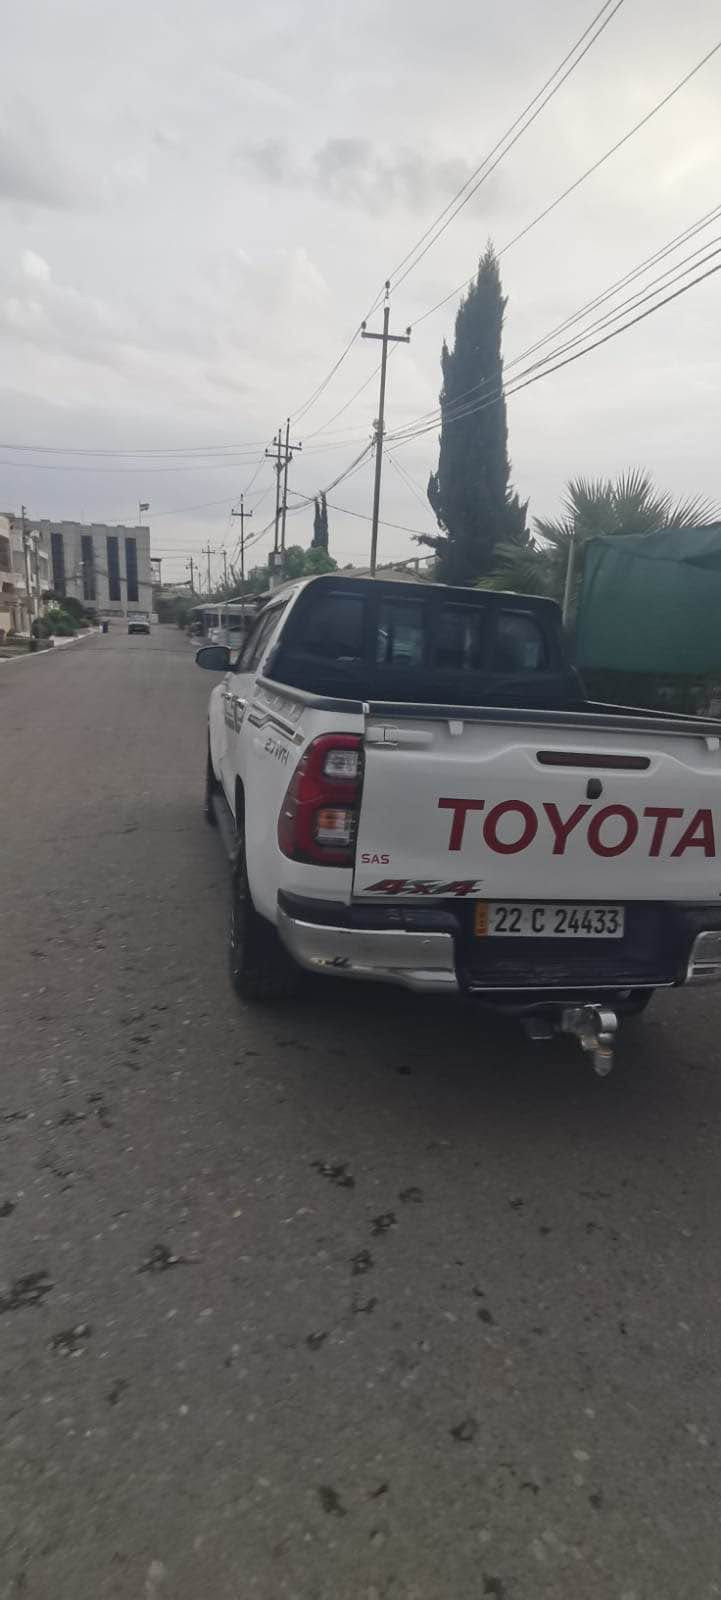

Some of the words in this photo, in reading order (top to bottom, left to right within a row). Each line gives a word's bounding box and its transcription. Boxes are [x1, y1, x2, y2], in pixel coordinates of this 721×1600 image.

[438, 798, 716, 857] TOYOTA
[361, 853, 389, 865] SAS
[495, 908, 521, 933] 22
[531, 909, 545, 932] C
[553, 909, 620, 934] 24433
